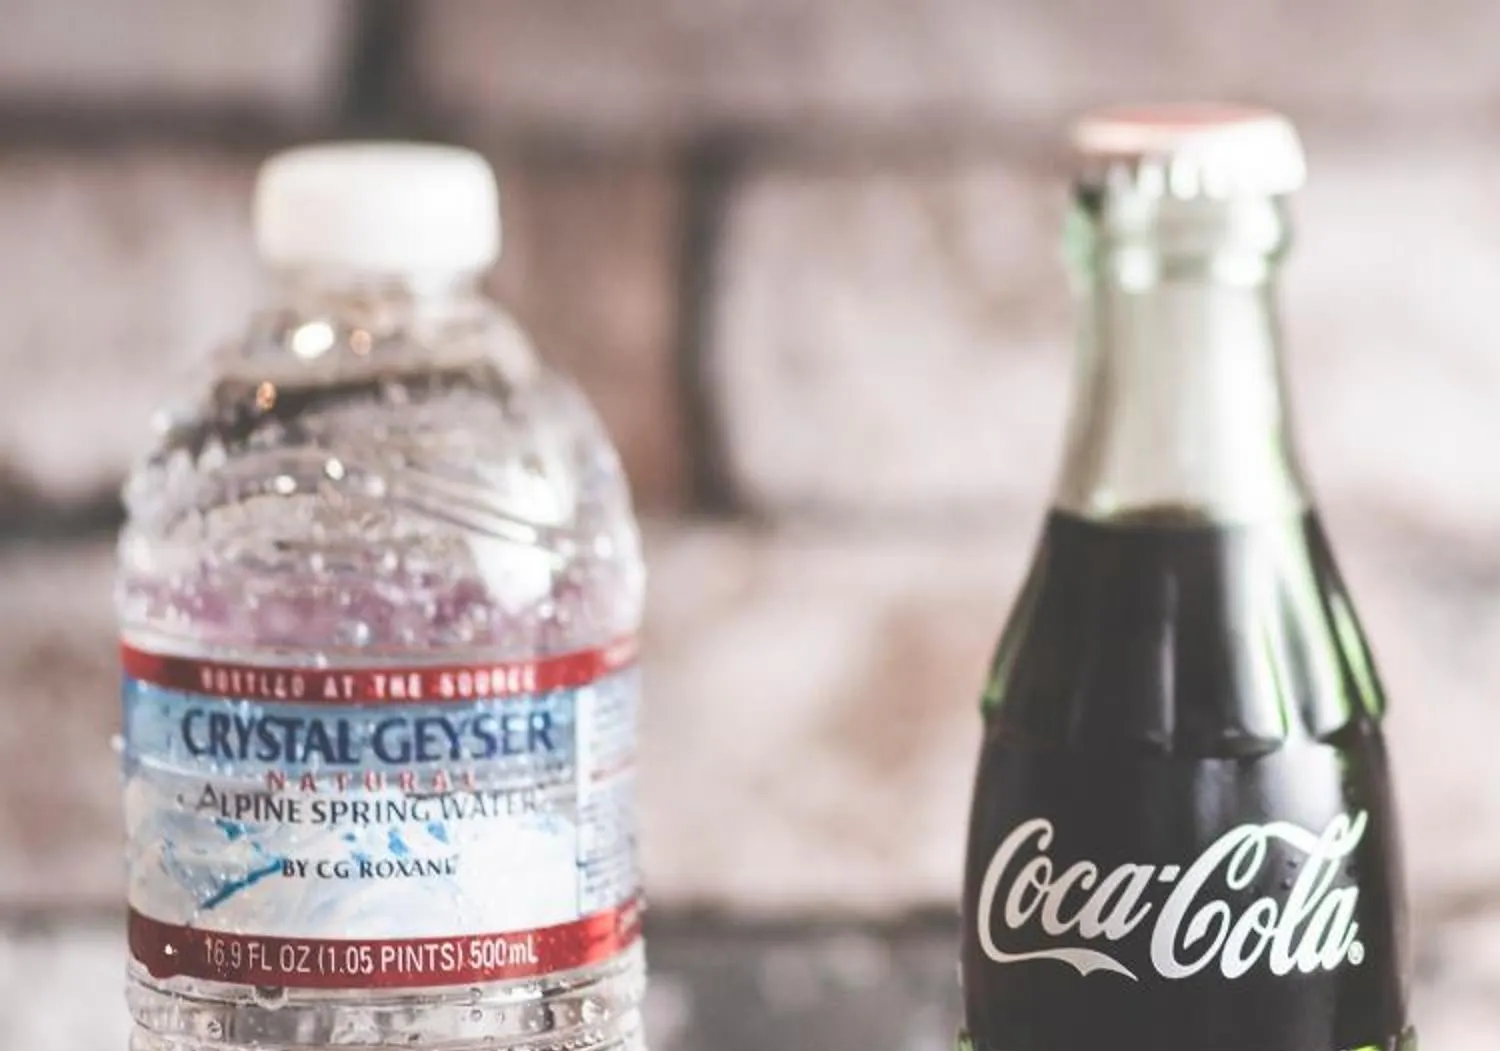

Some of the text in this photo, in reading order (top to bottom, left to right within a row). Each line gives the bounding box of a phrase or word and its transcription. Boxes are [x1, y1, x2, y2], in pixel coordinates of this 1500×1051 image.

[323, 677, 354, 698] AT
[373, 674, 422, 699] THE
[440, 664, 537, 699] SOURCE
[181, 709, 555, 764] CRYSTAL GEYSER
[264, 769, 477, 794] NATURAL
[197, 783, 537, 824] ALPINE SPRING WATER
[282, 859, 309, 877] BY
[317, 860, 350, 879] CG
[978, 811, 1367, 982] Coca-Cola
[204, 935, 539, 975] 16.9 FL OZ (1.05 PINTS) 500mL
